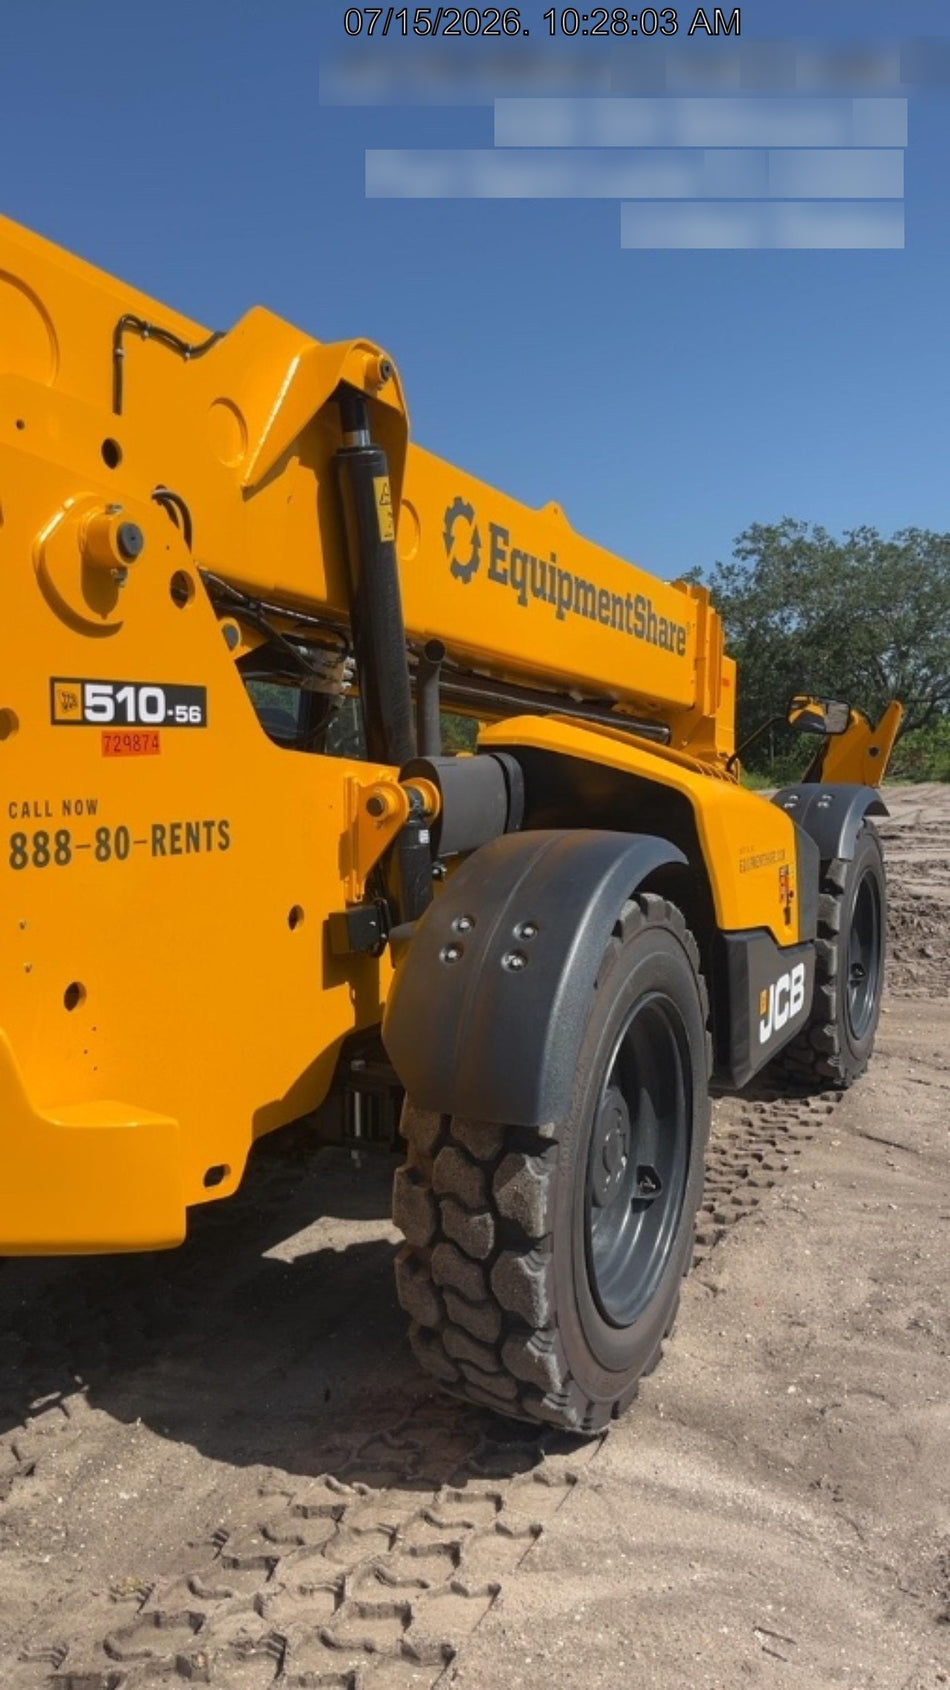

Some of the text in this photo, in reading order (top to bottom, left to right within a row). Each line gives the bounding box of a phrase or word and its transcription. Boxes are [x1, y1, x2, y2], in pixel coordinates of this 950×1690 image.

[487, 521, 687, 656] EquipmentShare
[104, 734, 160, 753] 729874
[8, 798, 98, 819] CALL NOW
[9, 819, 231, 871] 888-80-RENTS
[758, 962, 806, 1044] JCB
